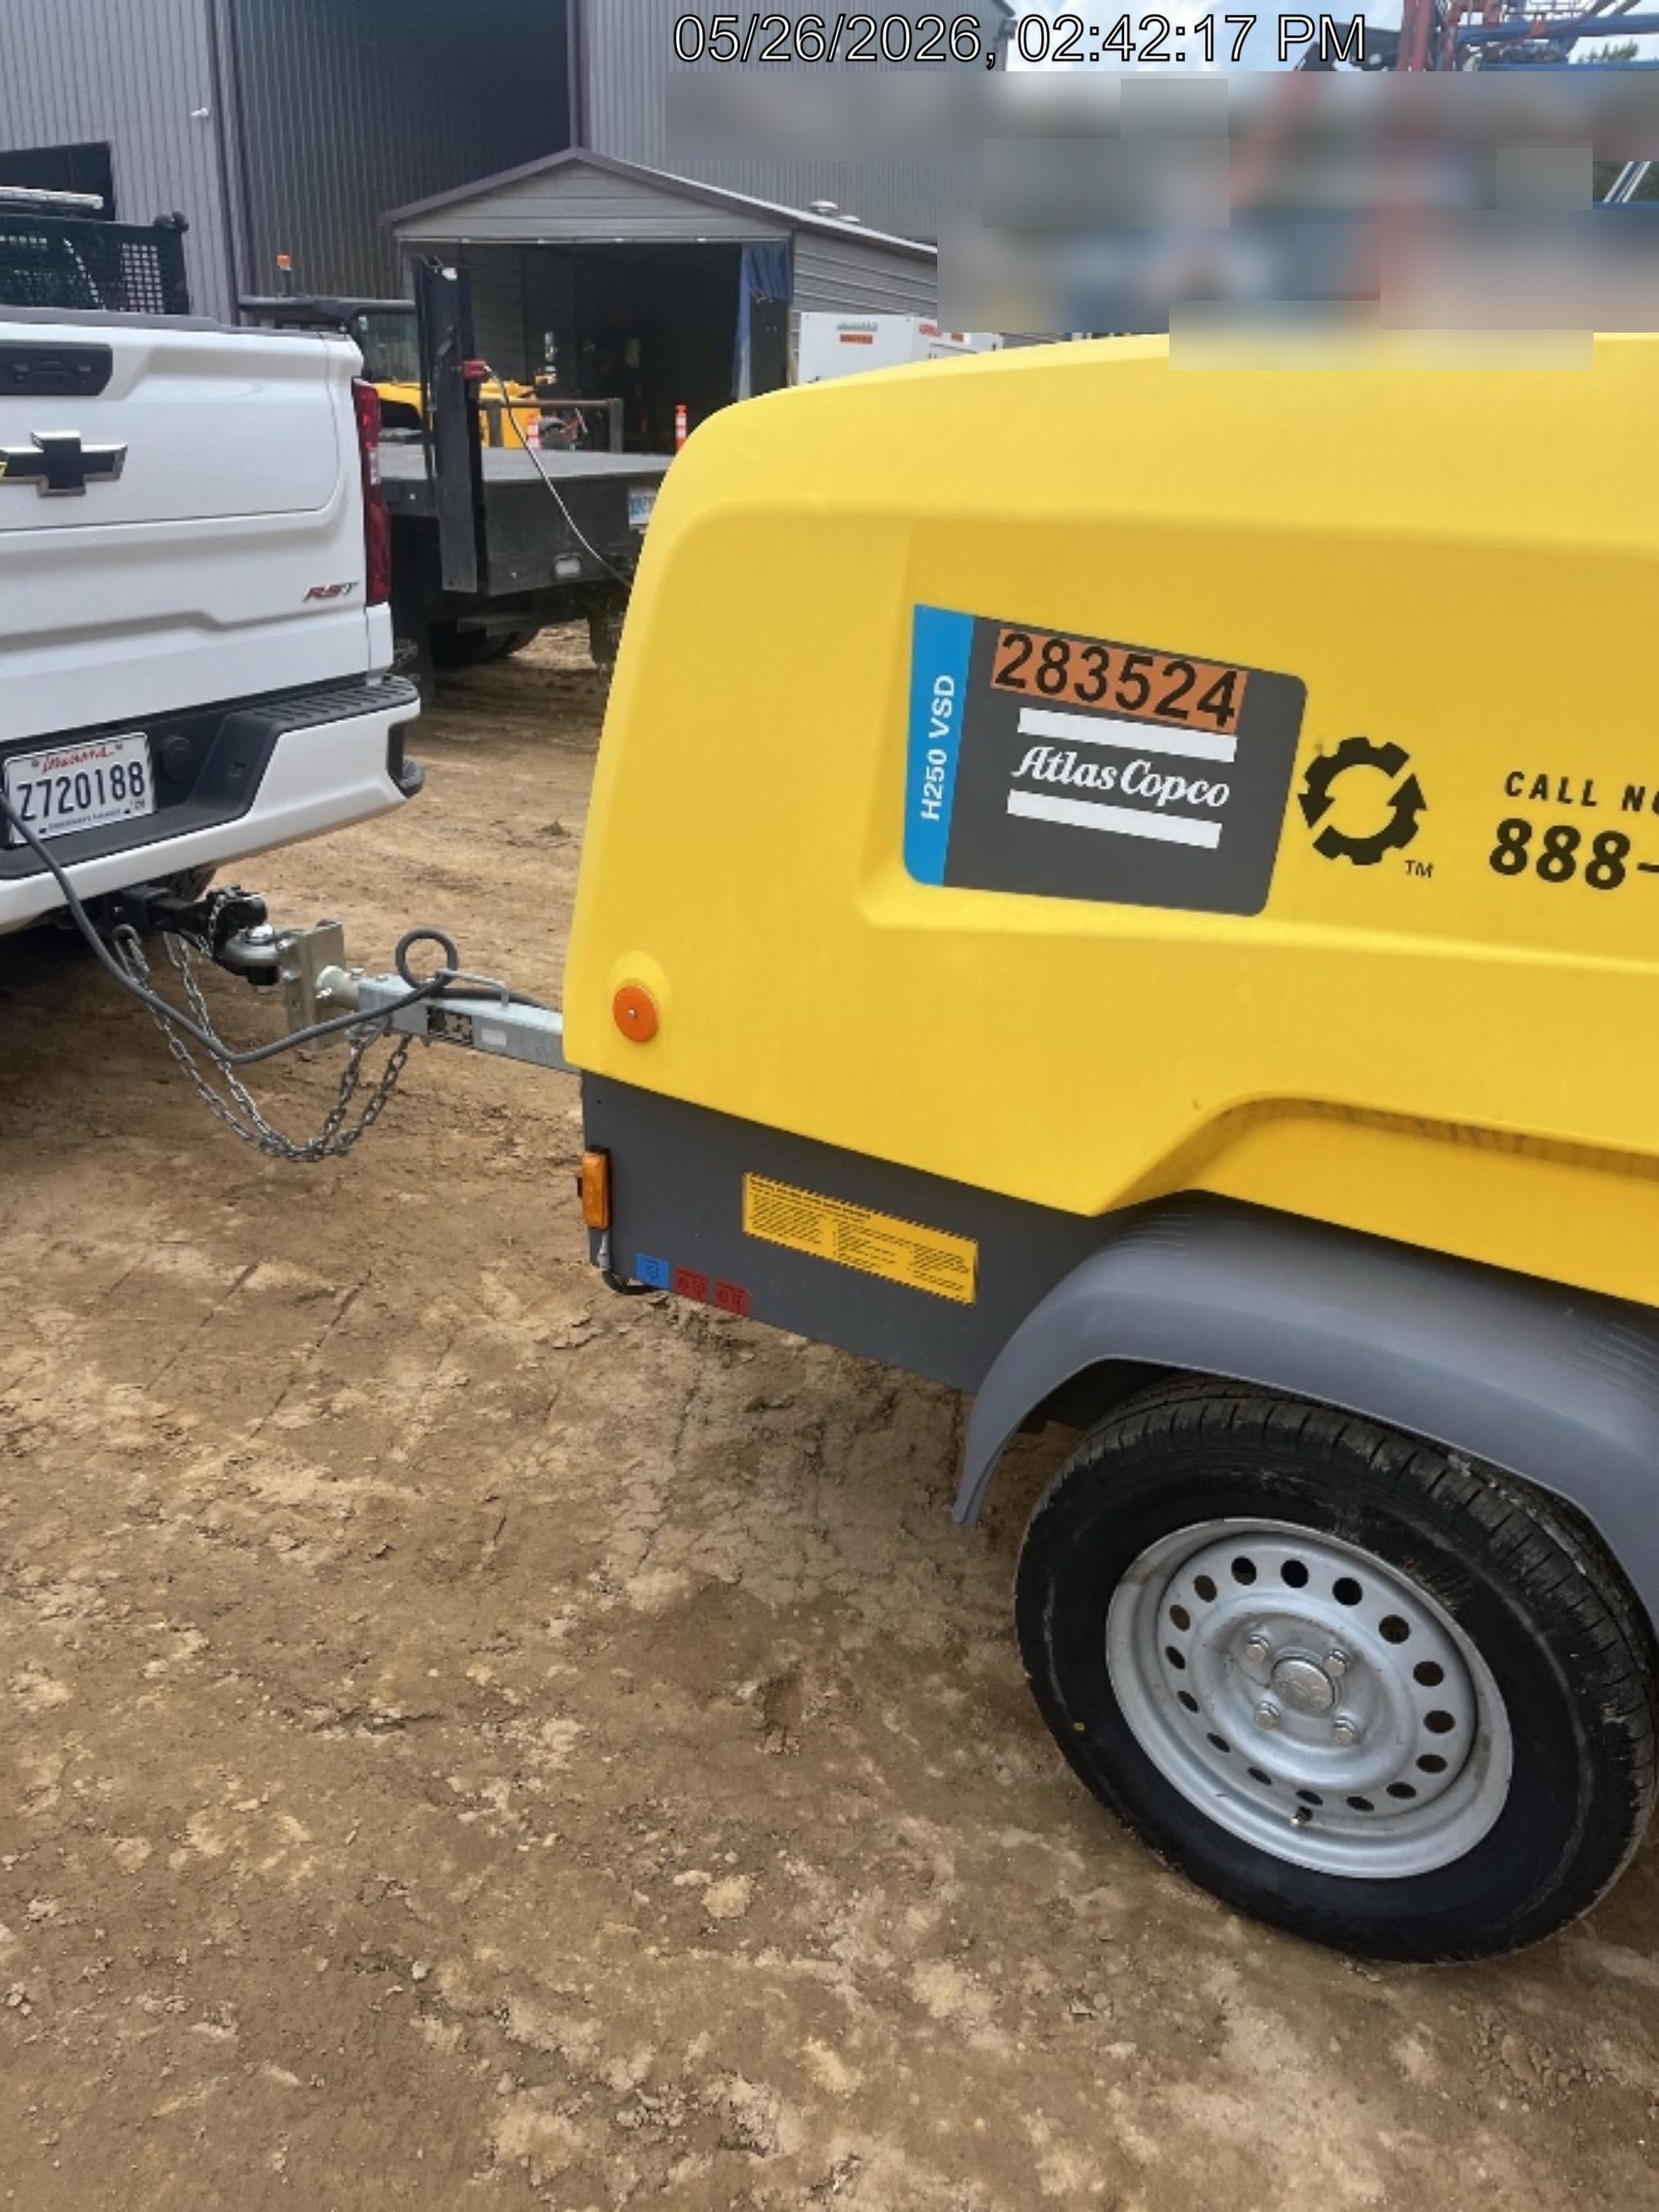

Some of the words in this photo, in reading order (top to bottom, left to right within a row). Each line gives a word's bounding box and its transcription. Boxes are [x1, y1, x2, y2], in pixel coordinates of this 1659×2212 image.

[928, 674, 955, 740] VSD
[995, 633, 1238, 728] 283524
[16, 761, 146, 821] Z720188
[921, 749, 948, 821] H250
[1011, 746, 1117, 790] Atlas
[1120, 759, 1230, 807] Copco
[1504, 771, 1598, 807] CALL
[1404, 859, 1434, 878] TM
[1489, 818, 1659, 891] 888-
